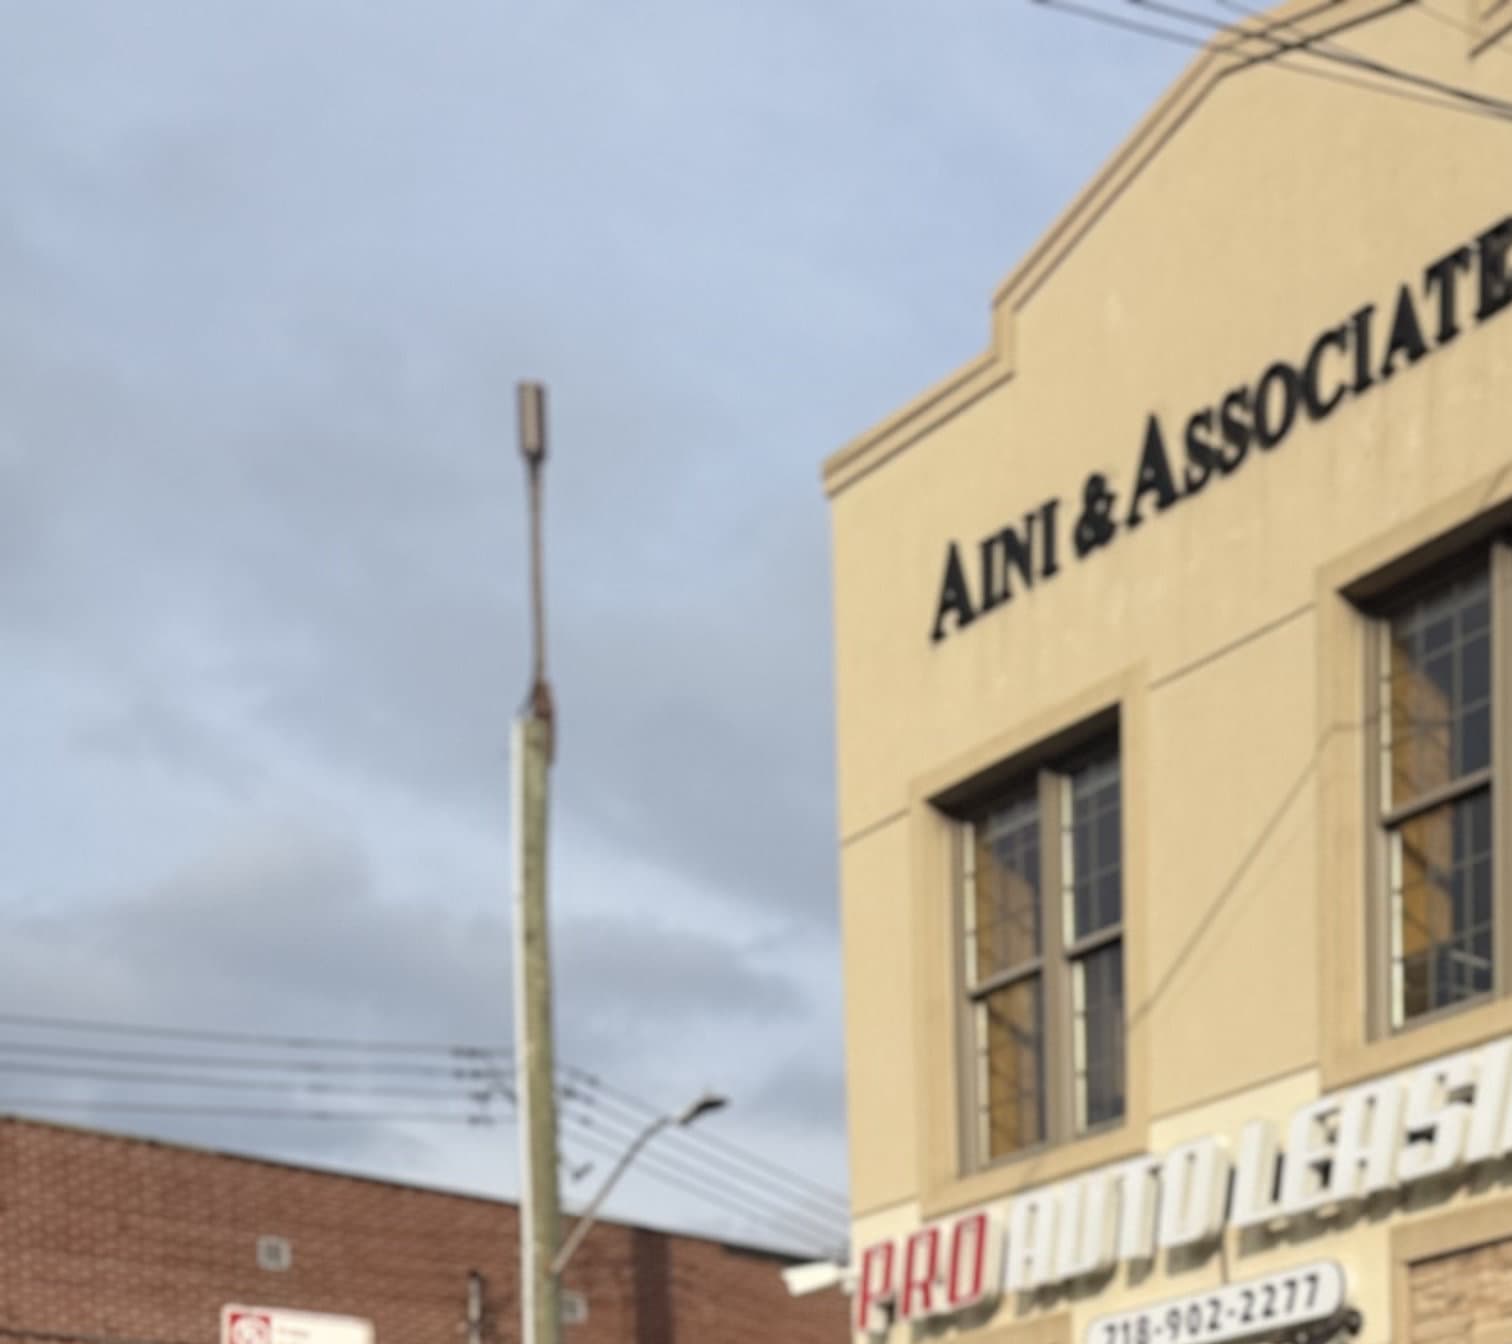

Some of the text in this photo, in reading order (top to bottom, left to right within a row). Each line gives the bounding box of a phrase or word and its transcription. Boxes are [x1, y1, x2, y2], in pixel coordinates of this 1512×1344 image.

[931, 538, 1061, 644] AINI
[1073, 472, 1117, 558] &
[855, 1212, 992, 1332] PRO
[1004, 1133, 1232, 1292] AUTO
